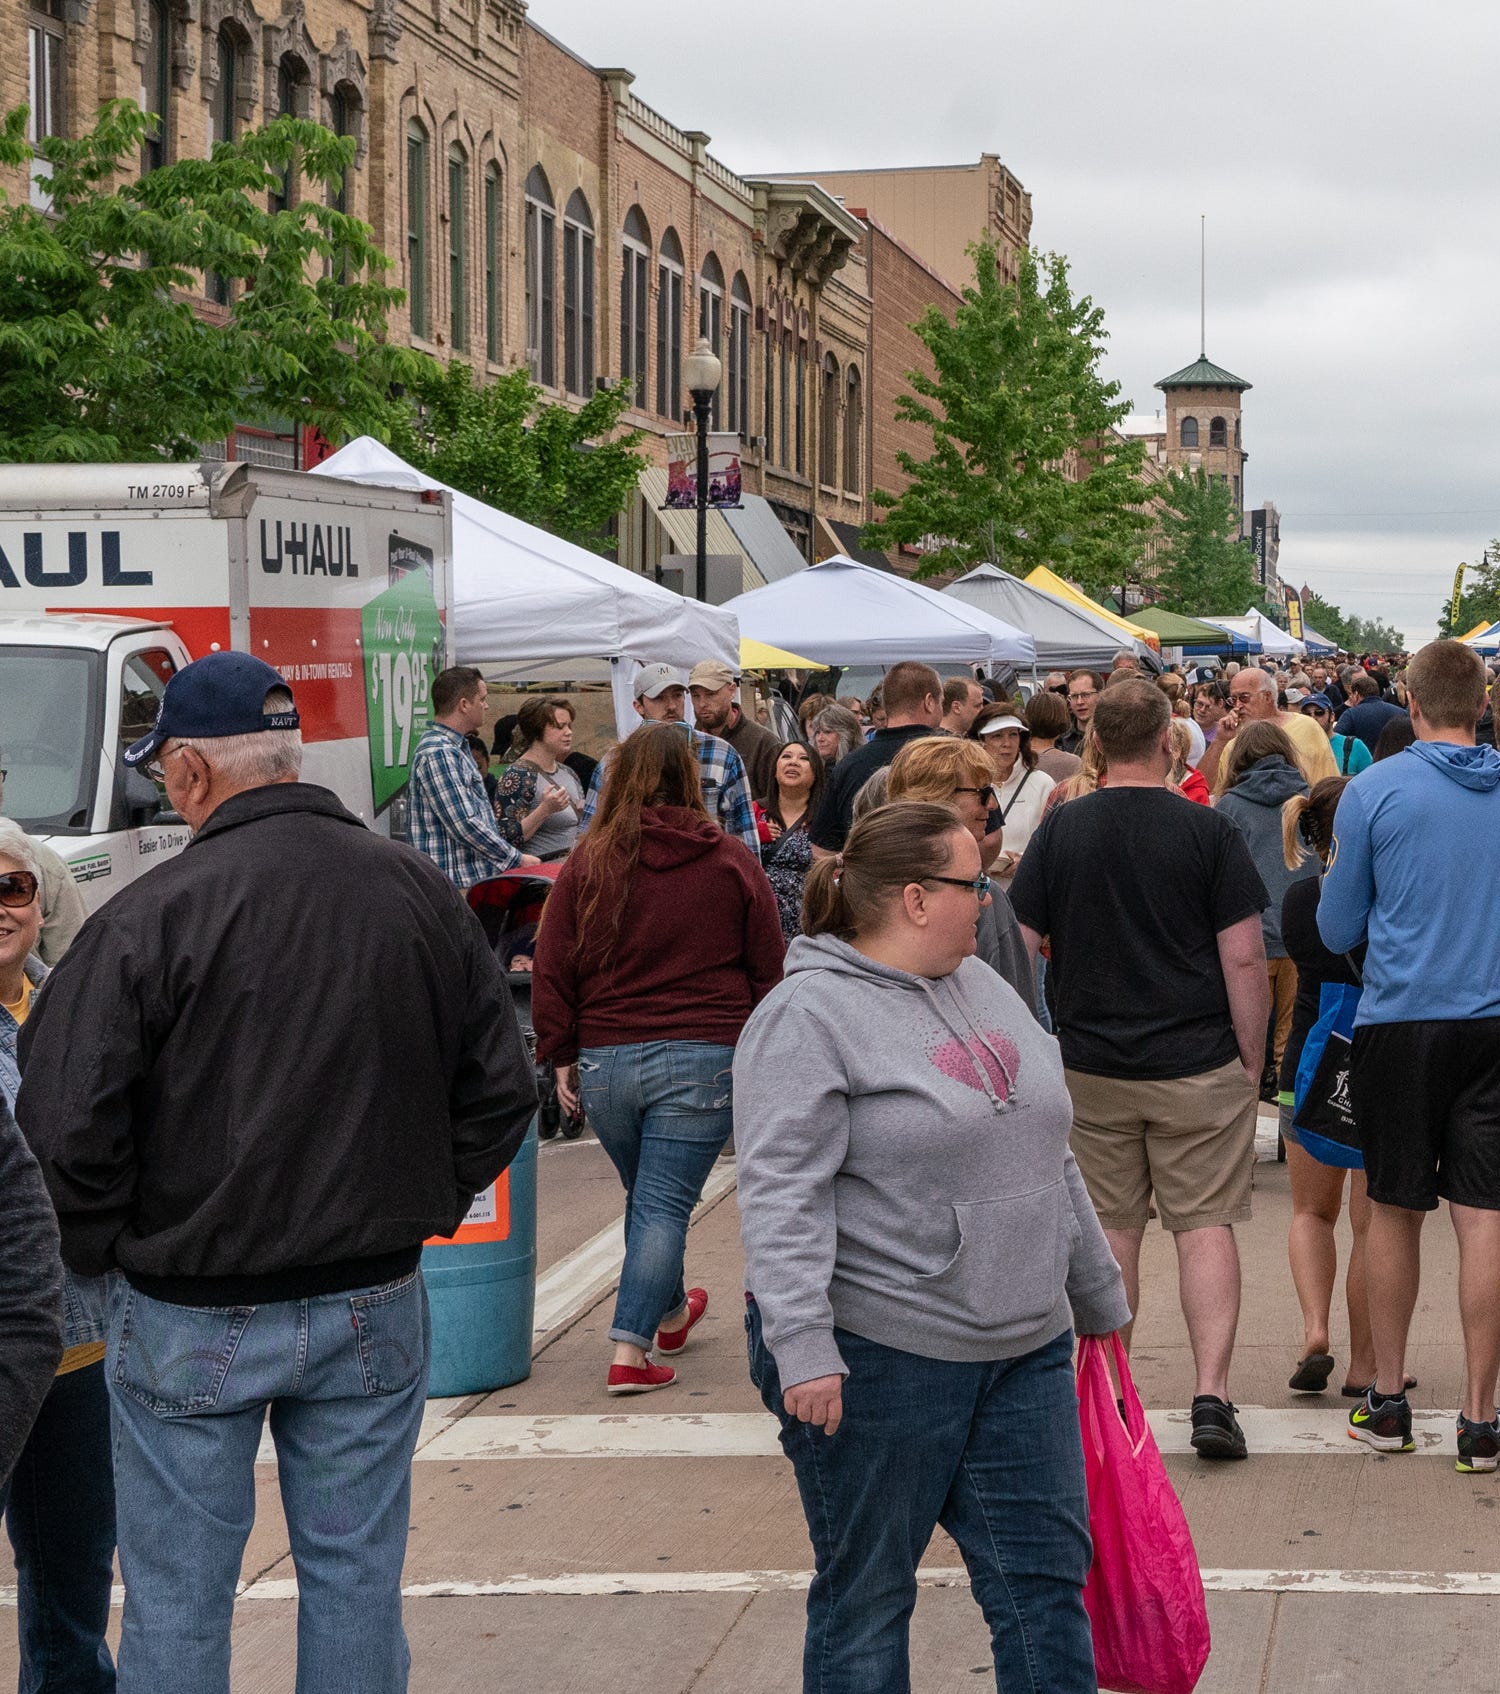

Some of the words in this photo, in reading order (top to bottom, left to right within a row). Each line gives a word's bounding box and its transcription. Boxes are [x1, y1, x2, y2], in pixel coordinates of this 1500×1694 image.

[128, 485, 148, 499] TM
[152, 484, 184, 498] 2709
[187, 485, 195, 498] F
[260, 519, 358, 577] U-HAUL
[395, 605, 416, 655] Only
[301, 664, 327, 680] IN-TOWN
[328, 662, 352, 679] RENTALS
[270, 717, 294, 727] NAVY
[139, 839, 158, 855] Easier
[158, 835, 167, 850] To
[168, 833, 183, 849] Drive
